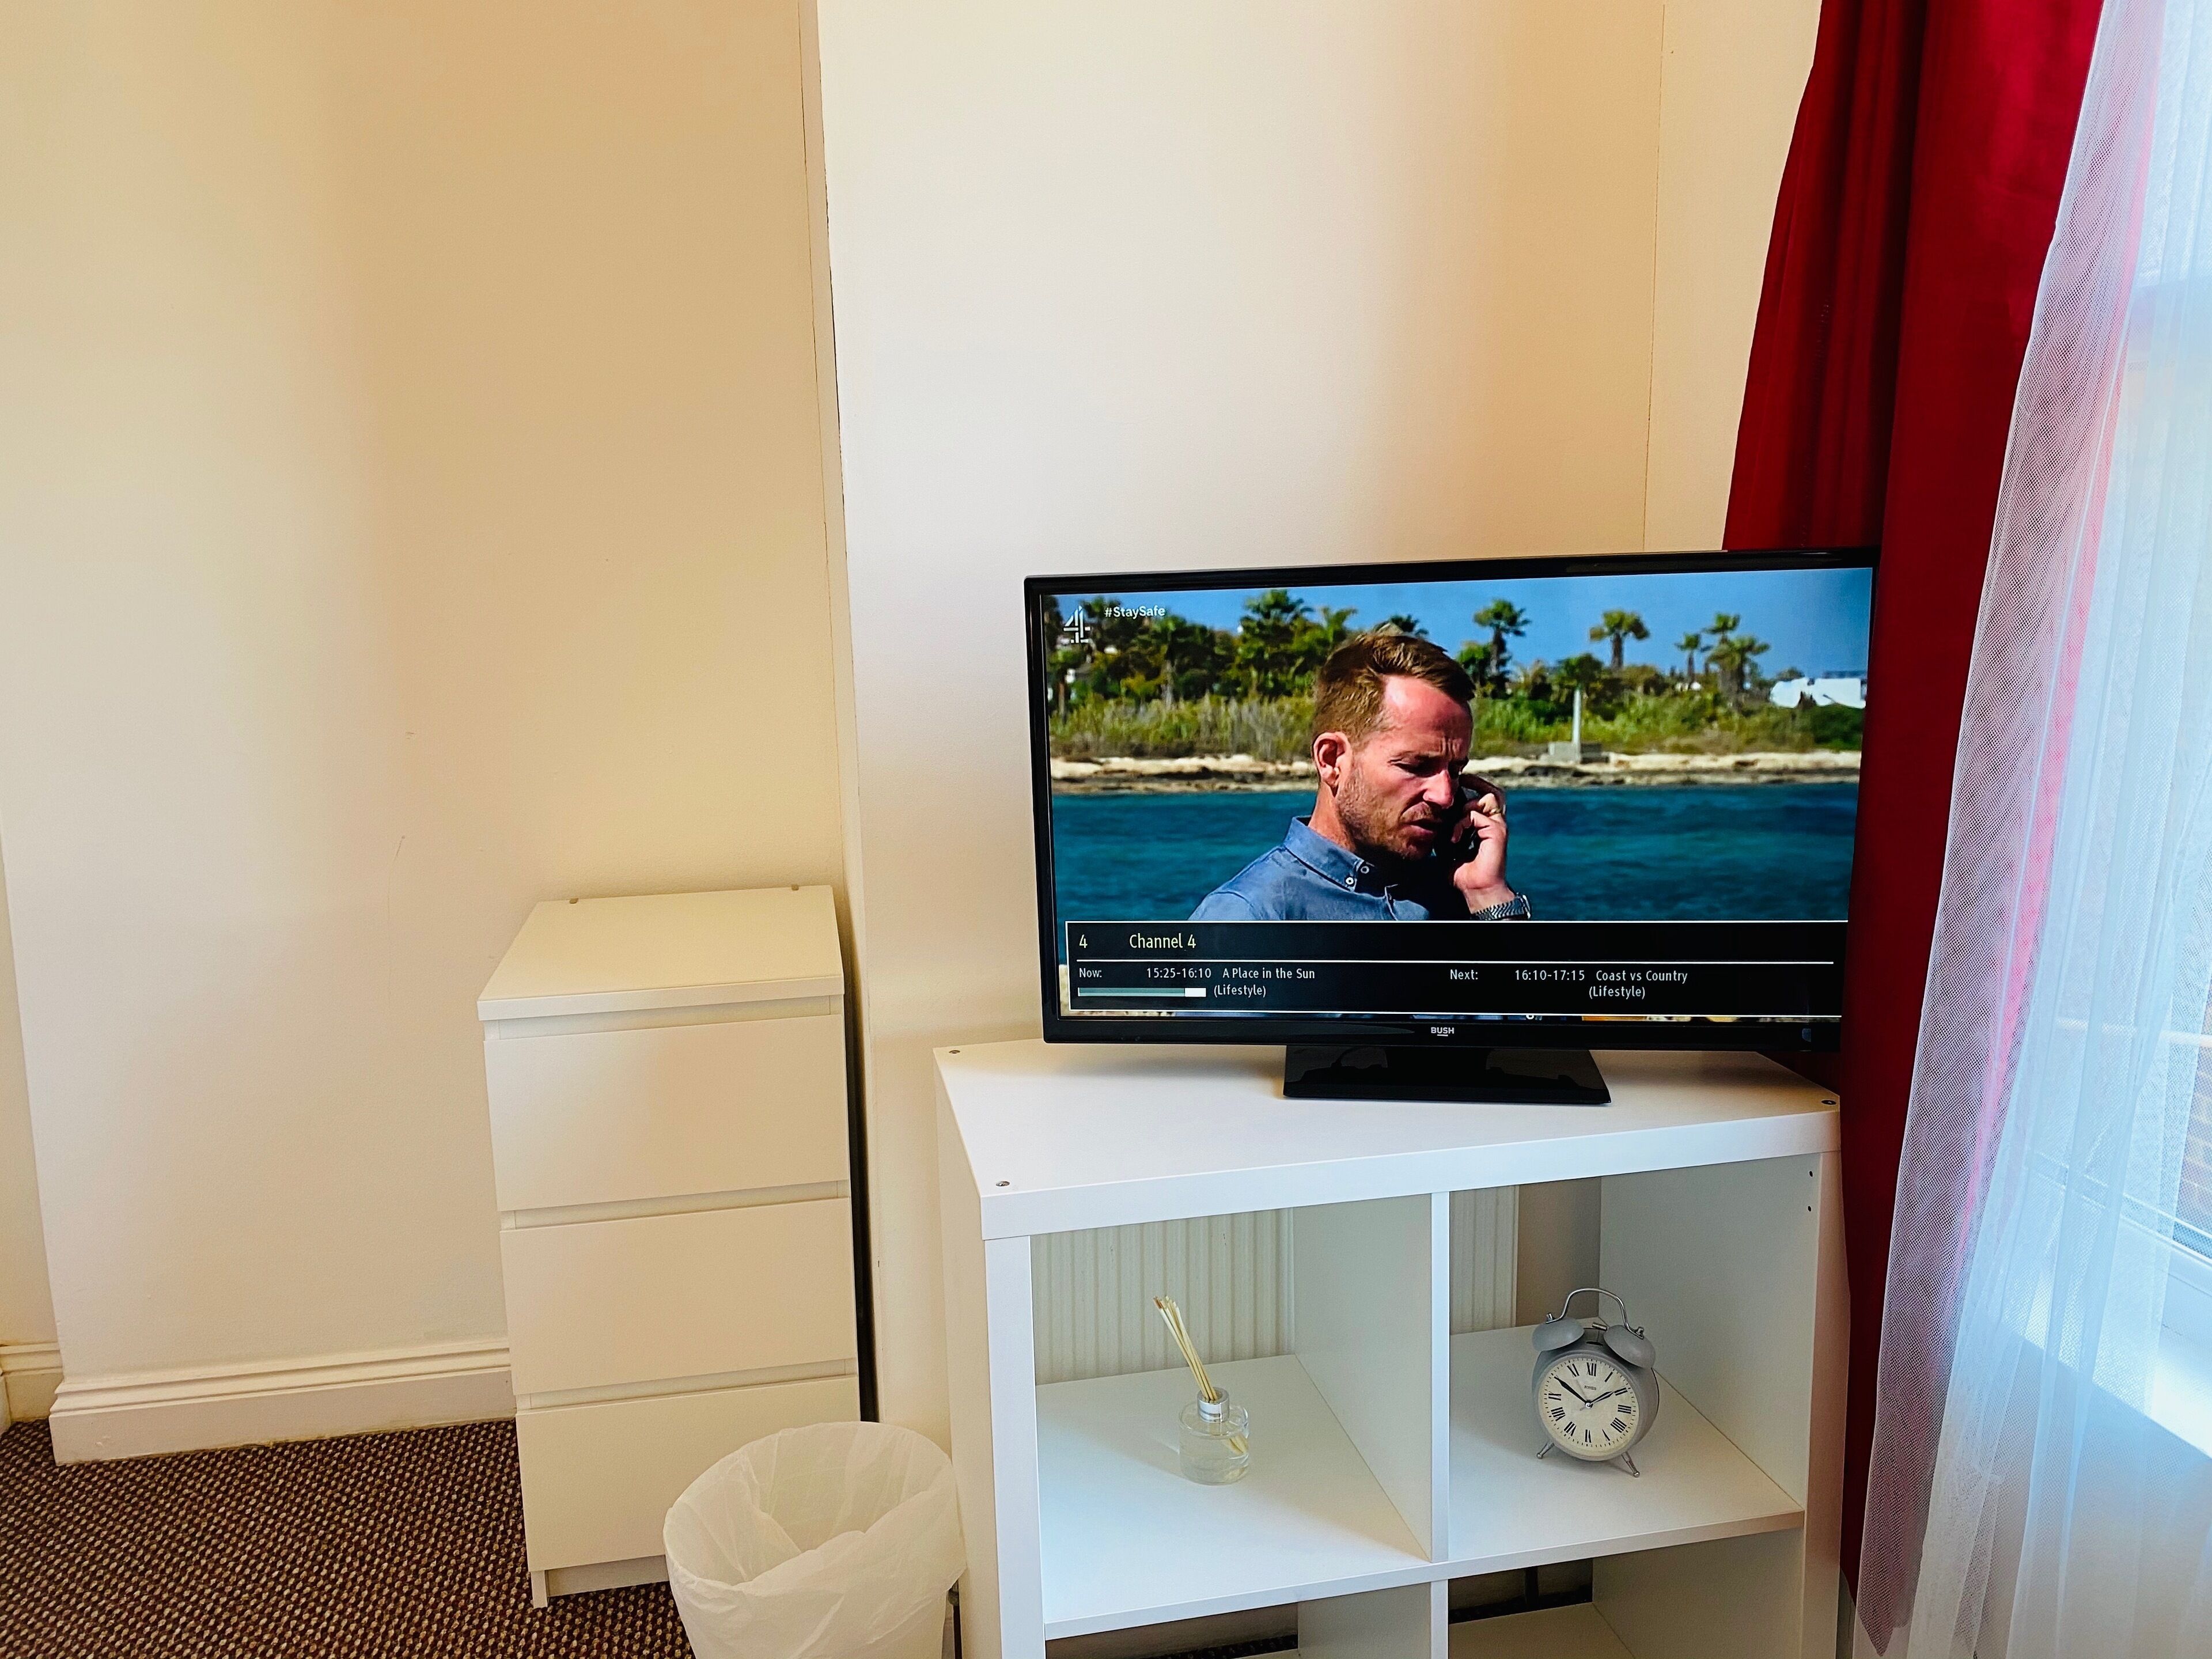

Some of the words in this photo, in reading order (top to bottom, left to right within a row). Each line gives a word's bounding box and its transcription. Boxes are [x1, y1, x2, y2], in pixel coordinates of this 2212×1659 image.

[1104, 605, 1165, 619] #StaySafe
[1079, 934, 1088, 949] 4
[1129, 933, 1183, 949] Channel
[1187, 934, 1196, 949] 4
[1079, 968, 1103, 979] Now:
[1146, 968, 1211, 979] 15:25-16:10
[1222, 968, 1230, 979] A
[1232, 967, 1259, 979] Place
[1262, 967, 1272, 979] in
[1275, 968, 1293, 979] the
[1296, 968, 1315, 979] Sun
[1450, 969, 1479, 980] Next:
[1515, 970, 1585, 981] 16:10-17:15
[1596, 970, 1626, 982] Coast
[1630, 972, 1642, 982] vs
[1646, 970, 1688, 984] Country
[1213, 984, 1267, 998] (Lifestyle)
[1589, 985, 1646, 999] (Lifestyle)
[1430, 1027, 1455, 1035] BUSH
